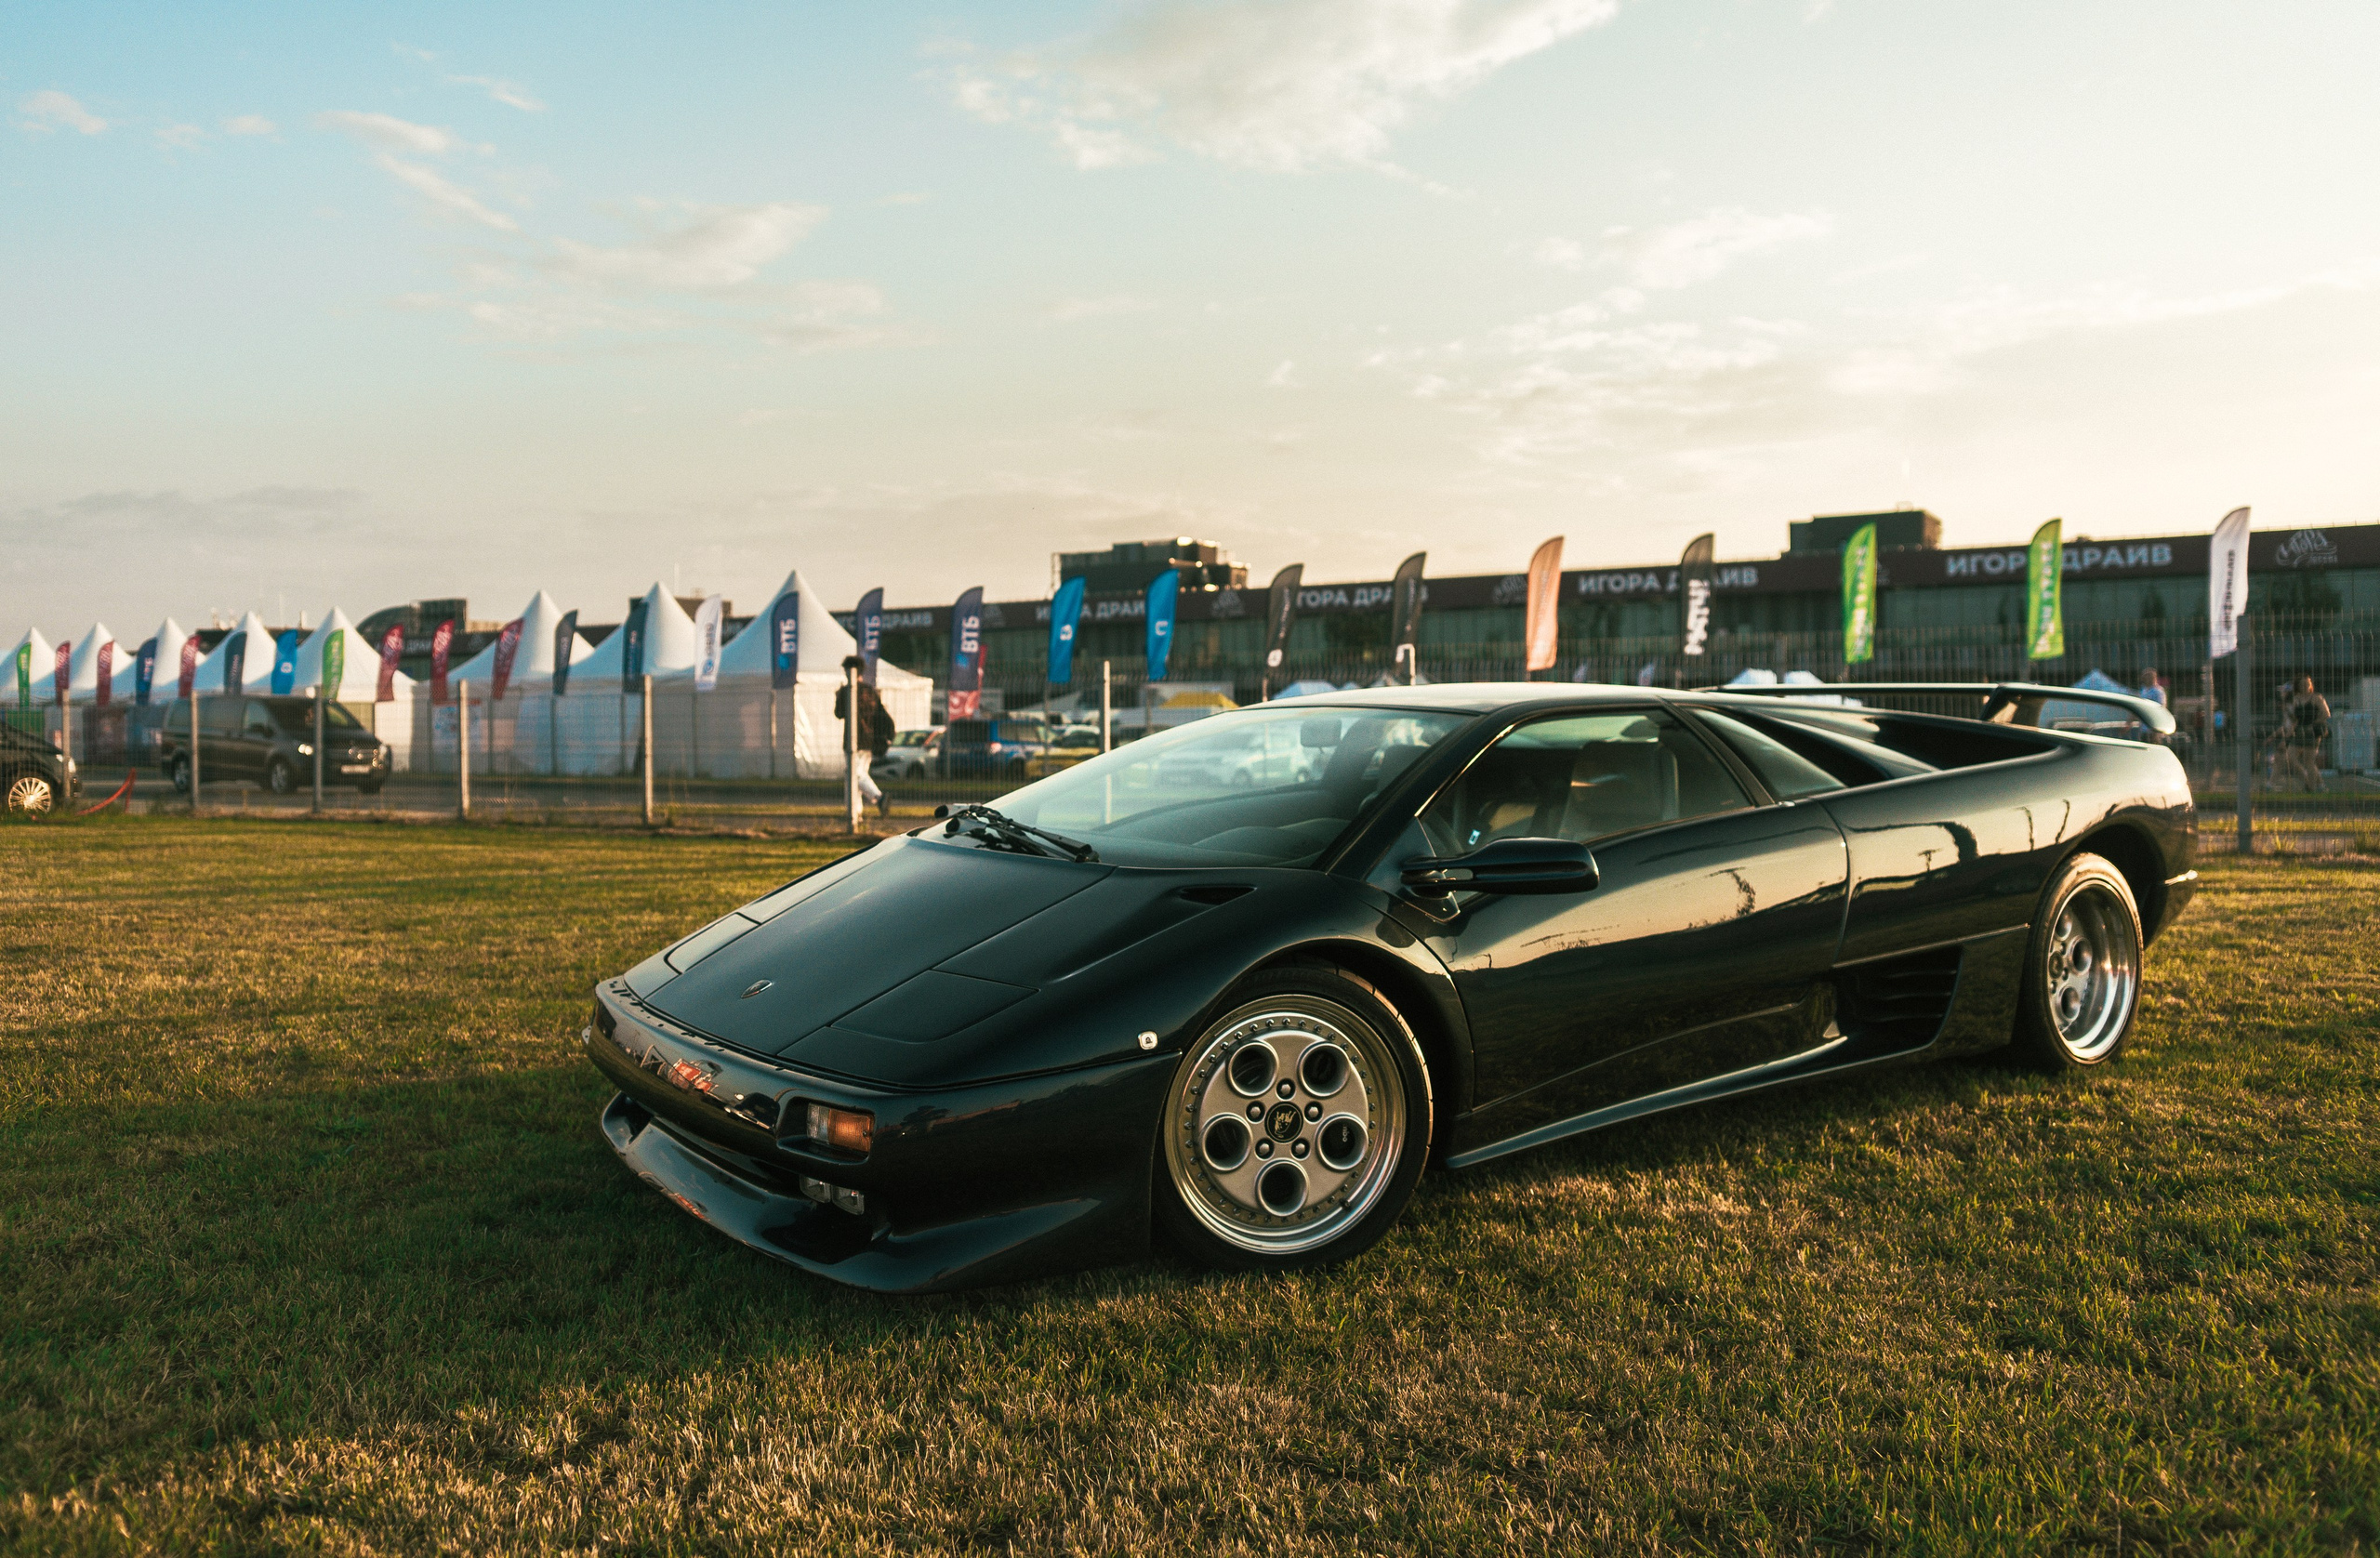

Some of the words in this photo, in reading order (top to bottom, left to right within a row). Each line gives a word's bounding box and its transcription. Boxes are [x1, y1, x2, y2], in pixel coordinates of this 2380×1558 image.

[1946, 552, 2027, 576] ИГОР
[1578, 572, 1662, 594] ИГОРА
[1296, 589, 1349, 608] ГОРА
[780, 618, 796, 654] ВТБ
[865, 615, 880, 651] ВТБ
[960, 615, 979, 654] ВТБ
